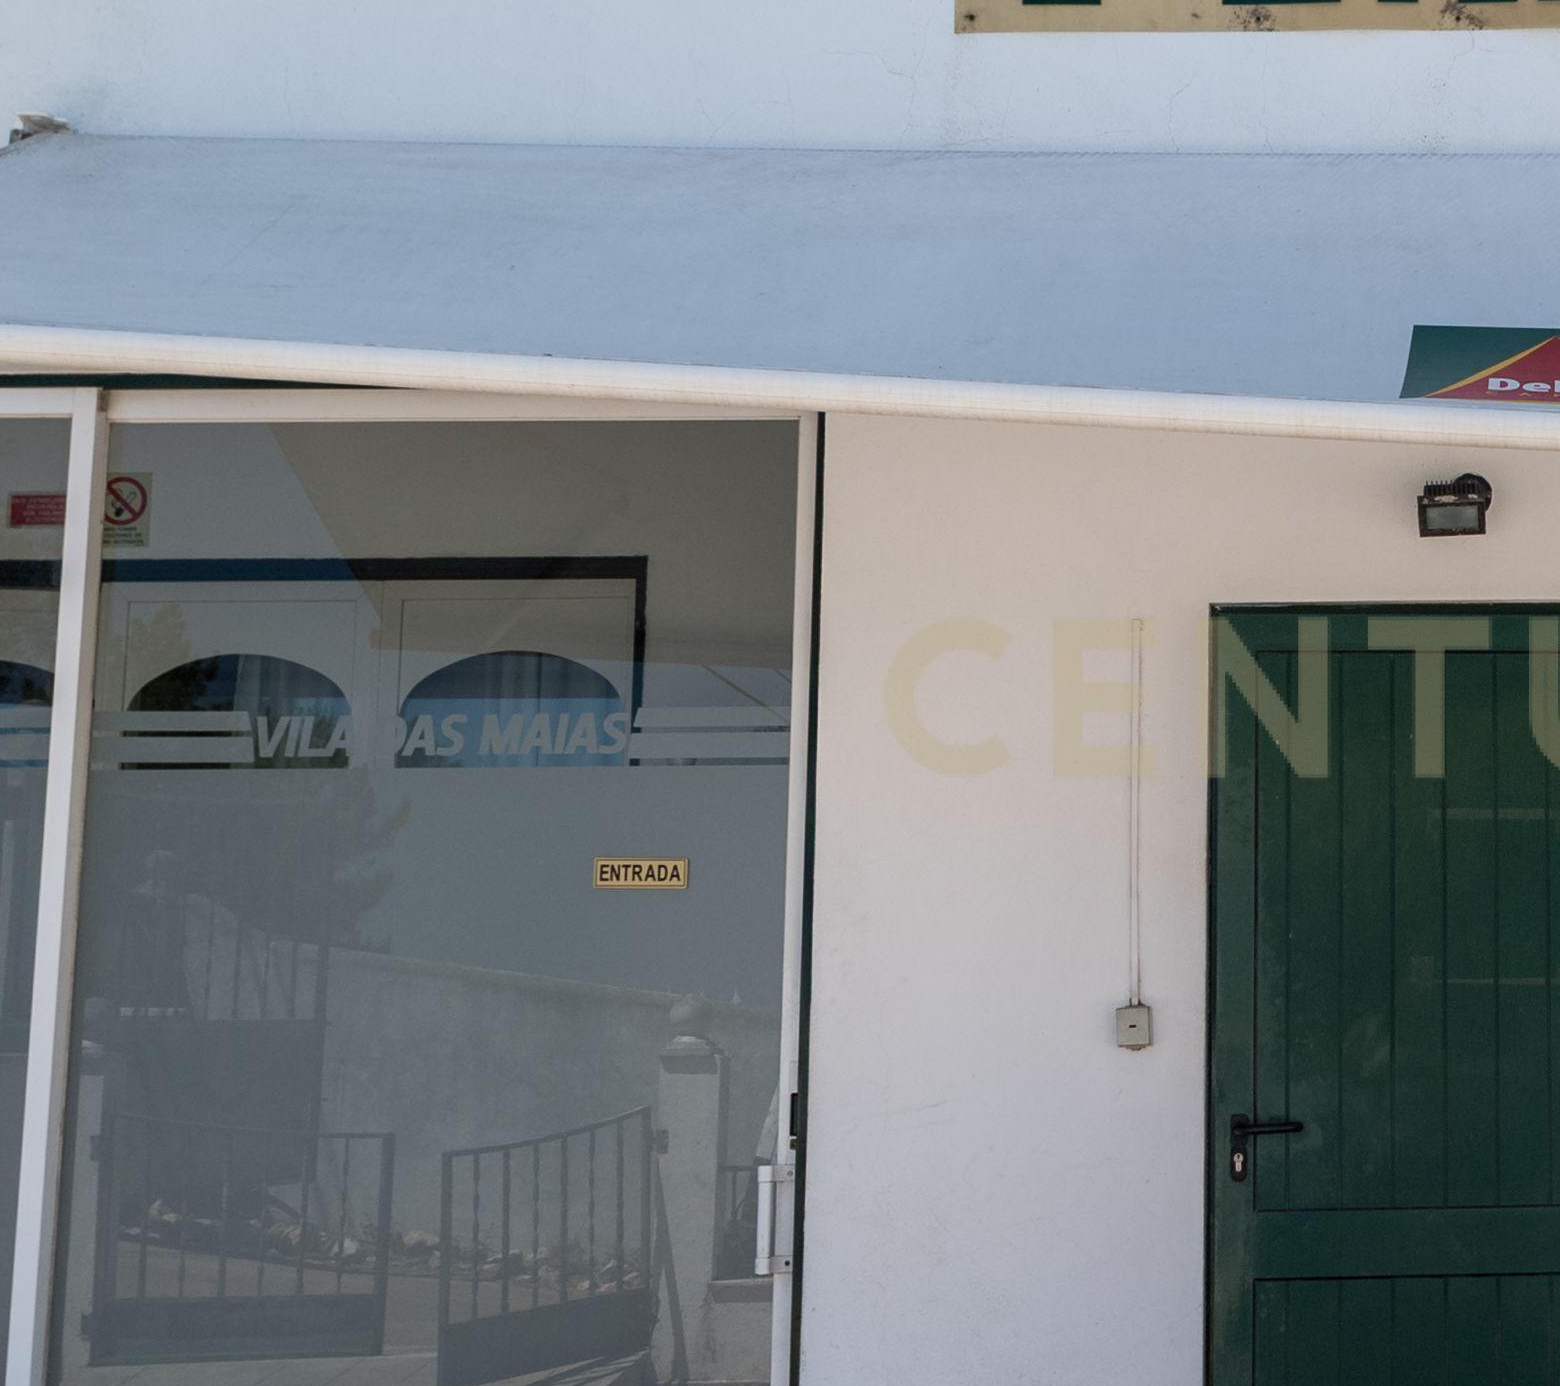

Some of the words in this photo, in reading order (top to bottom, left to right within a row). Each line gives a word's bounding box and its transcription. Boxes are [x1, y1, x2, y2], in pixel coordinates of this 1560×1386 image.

[254, 715, 353, 760] VILA
[477, 712, 632, 756] MAIAS
[598, 862, 684, 886] ENTRADA
